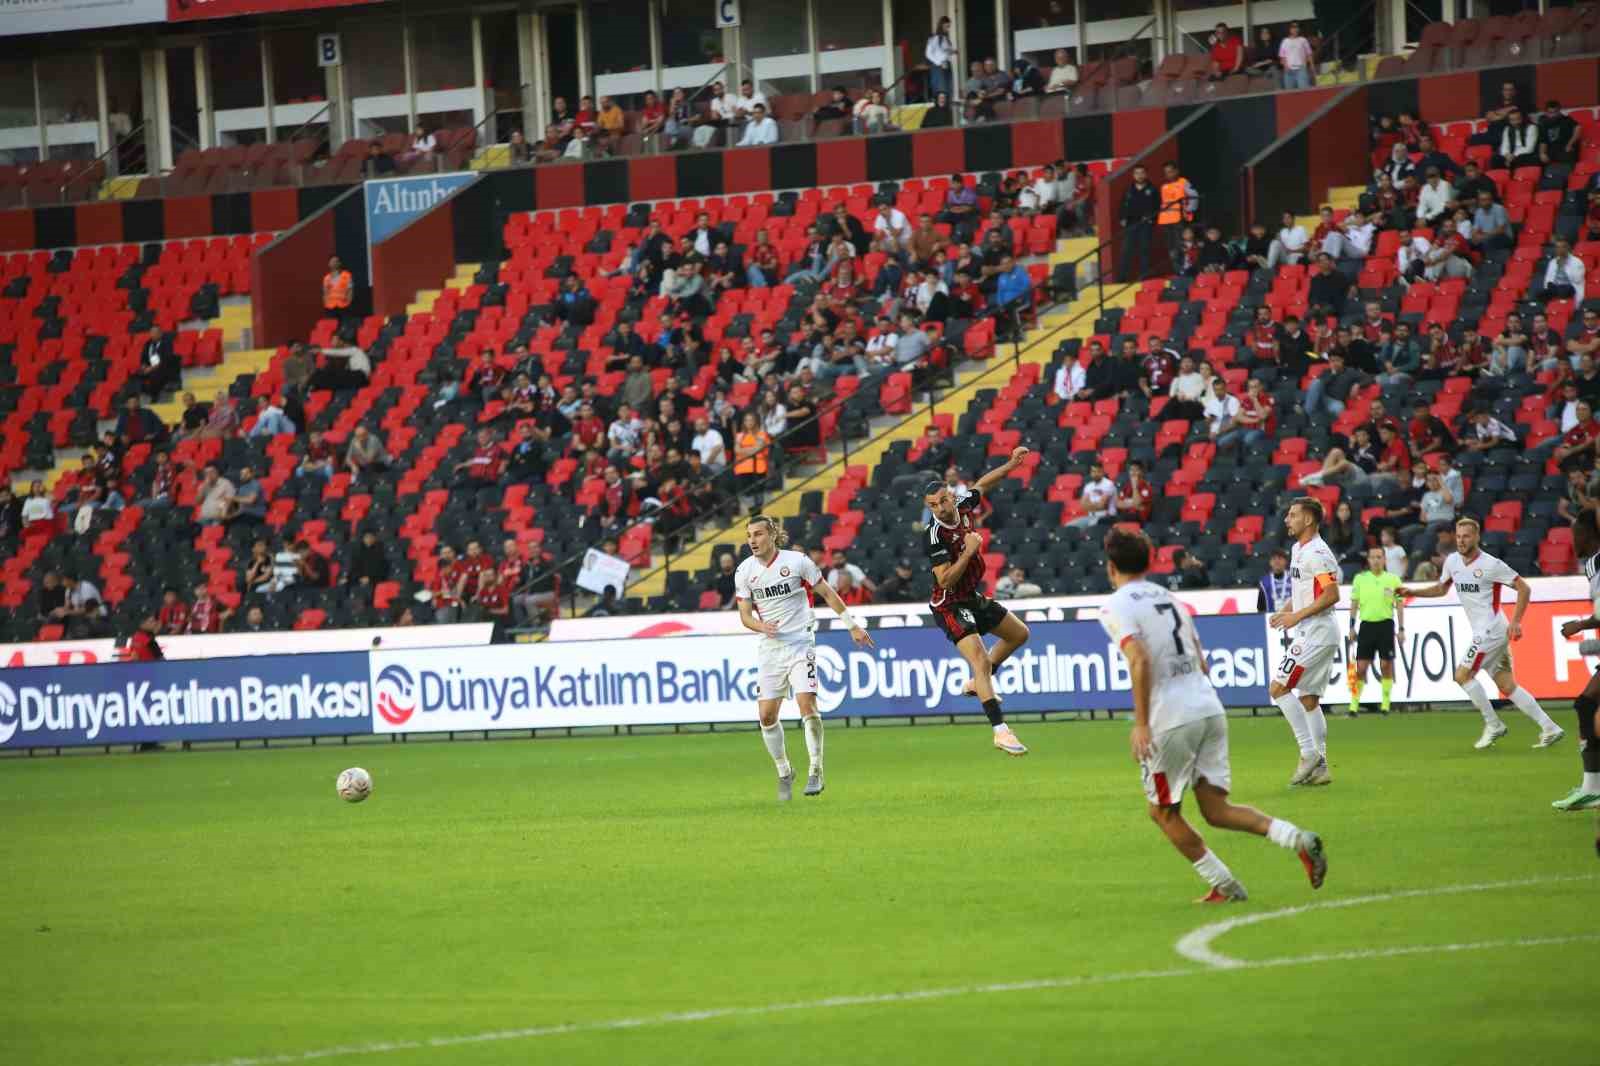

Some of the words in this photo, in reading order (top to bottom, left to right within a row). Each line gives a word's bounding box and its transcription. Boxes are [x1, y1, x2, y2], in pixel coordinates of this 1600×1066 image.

[720, 0, 735, 23] C
[323, 38, 336, 61] B
[374, 180, 456, 214] Altınb
[765, 583, 791, 598] ARCA
[1153, 602, 1185, 656] 7
[420, 667, 530, 721] Dünya
[534, 663, 651, 708] Katılım
[656, 658, 760, 704] Banka
[848, 648, 970, 708] Dünya
[992, 644, 1105, 694] atılım
[19, 684, 125, 739] Dünya
[126, 679, 240, 727] Katılım
[240, 674, 370, 722] Bankası
